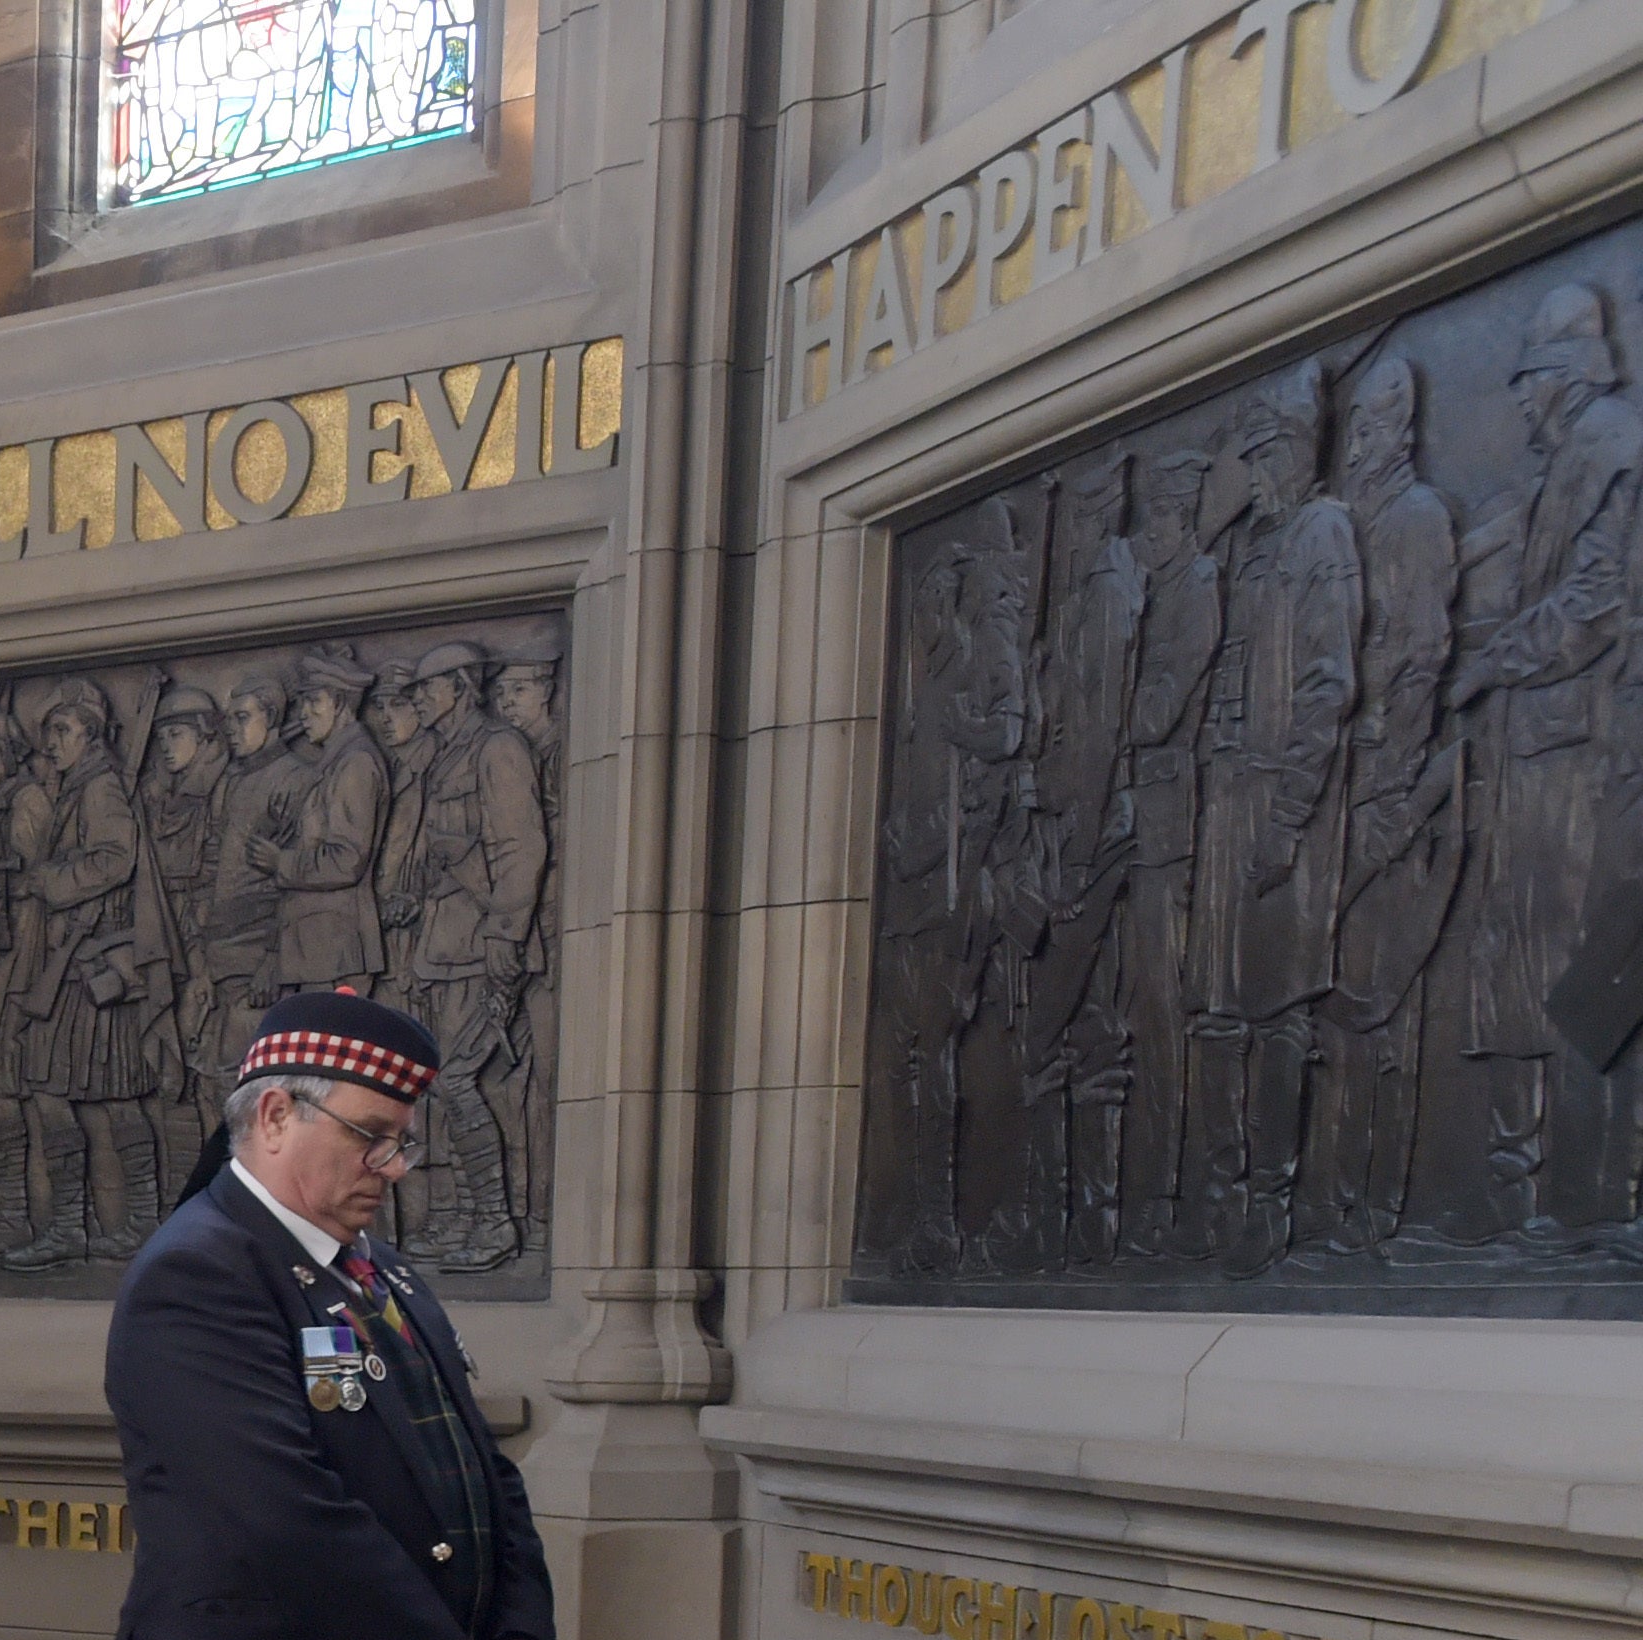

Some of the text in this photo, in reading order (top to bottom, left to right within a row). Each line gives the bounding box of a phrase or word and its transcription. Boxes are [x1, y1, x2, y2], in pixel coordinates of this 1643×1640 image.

[782, 0, 1444, 422] HAPPEN TO
[115, 400, 313, 542] NO
[345, 342, 620, 508] EVIL
